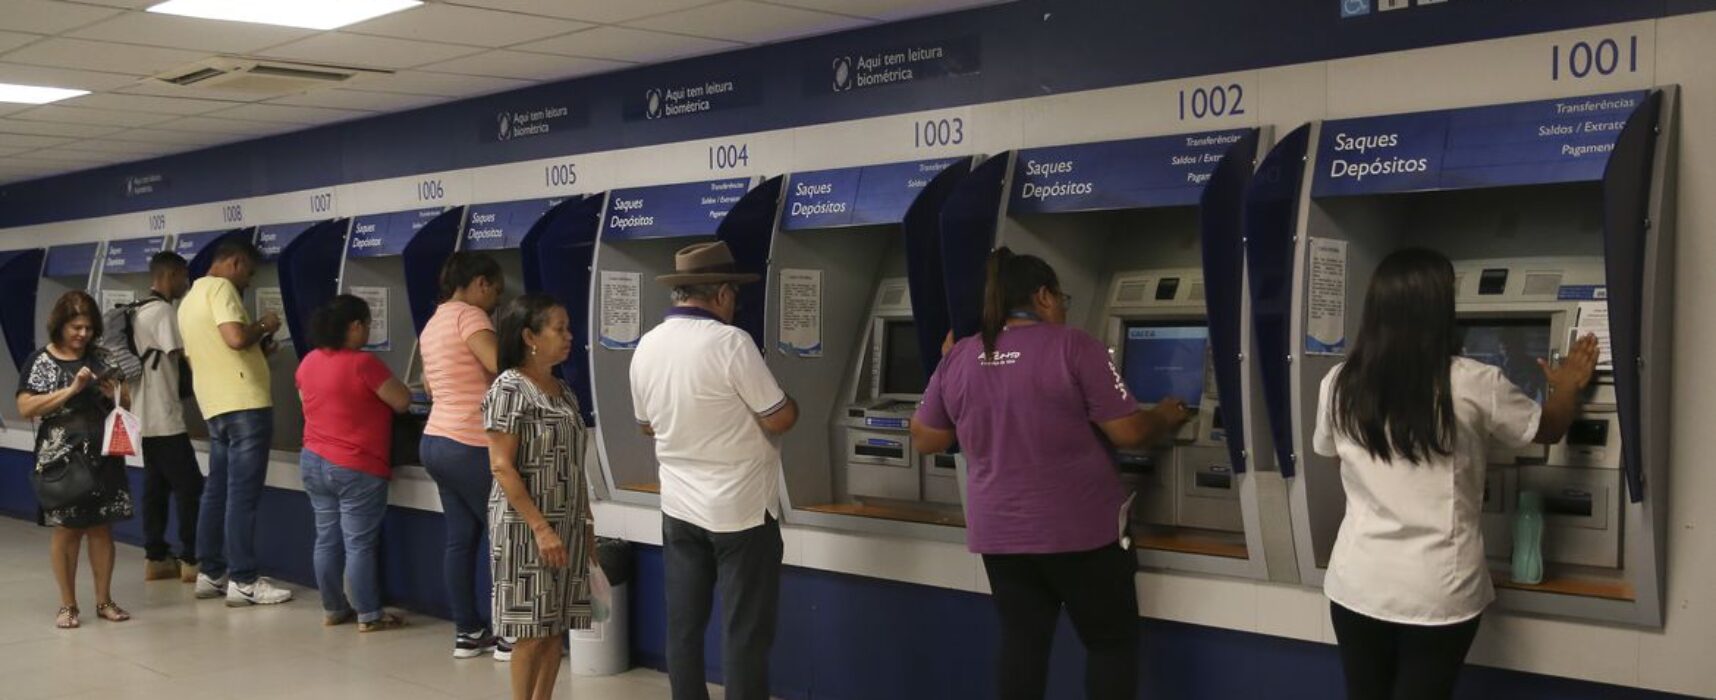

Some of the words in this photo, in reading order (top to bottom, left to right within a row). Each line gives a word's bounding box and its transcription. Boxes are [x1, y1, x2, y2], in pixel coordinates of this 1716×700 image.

[857, 55, 881, 72] Aqui
[884, 53, 905, 66] tem
[908, 47, 943, 63] leitura
[1552, 35, 1637, 80] 1001
[857, 67, 913, 87] biométrica
[665, 88, 685, 103] Aqui
[686, 86, 704, 98] tem
[705, 82, 733, 95] leitura
[1179, 83, 1245, 120] 1002
[665, 100, 711, 116] biométrica
[1556, 98, 1635, 114] Transferências
[914, 117, 963, 148] 1003
[1538, 125, 1573, 136] Saldos
[1584, 120, 1626, 132] Extrato
[1334, 132, 1399, 154] Saques
[709, 143, 748, 170] 1004
[1171, 155, 1196, 166] Saldos
[545, 163, 577, 187] 1005
[1025, 159, 1073, 178] Saques
[1330, 156, 1428, 181] Depósitos
[418, 180, 444, 201] 1006
[795, 182, 833, 198] Saques
[1021, 181, 1093, 201] Depósitos
[310, 192, 331, 213] 1007
[614, 198, 644, 213] Saques
[791, 200, 847, 218] Depósitos
[222, 204, 243, 223] 1008
[472, 212, 496, 225] Saques
[610, 215, 654, 231] Depósitos
[467, 227, 504, 241] Depósitos
